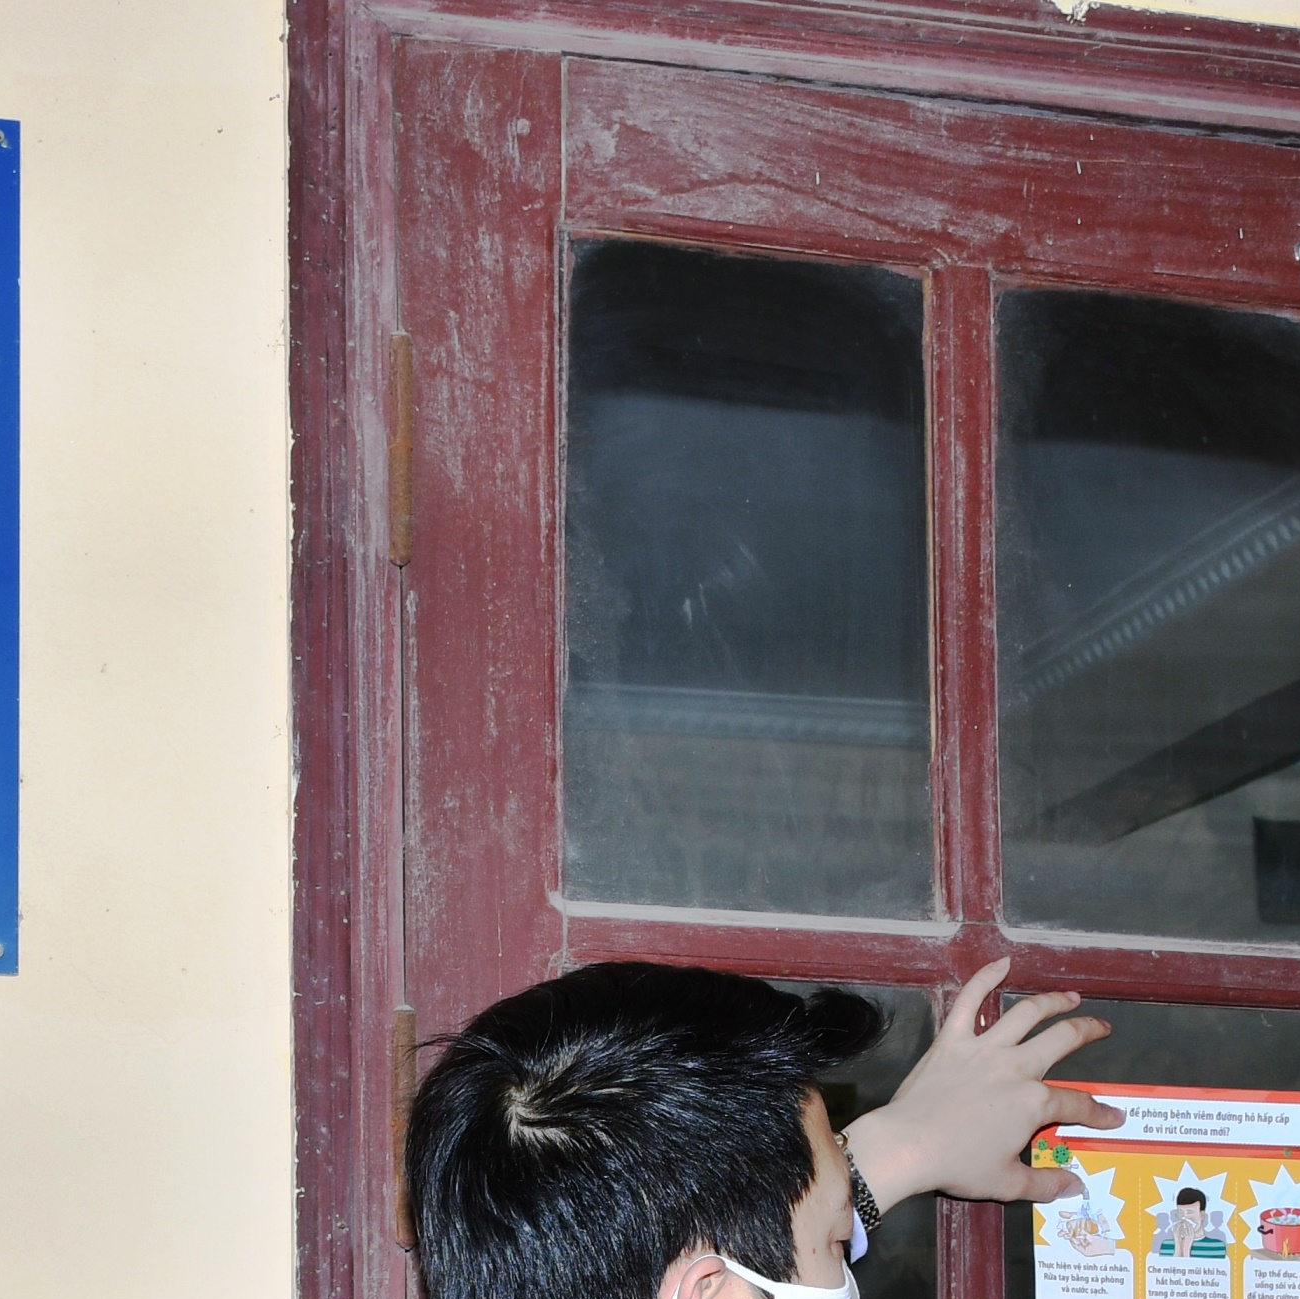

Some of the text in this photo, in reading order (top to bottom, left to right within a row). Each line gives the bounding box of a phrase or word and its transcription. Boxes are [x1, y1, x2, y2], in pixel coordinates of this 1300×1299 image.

[1142, 1108, 1168, 1121] phòng
[1170, 1109, 1191, 1121] bệnh
[1193, 1110, 1214, 1120] viêm
[1216, 1111, 1242, 1124] đường
[1245, 1112, 1255, 1122] hô
[1257, 1112, 1273, 1125] hấp
[1275, 1112, 1290, 1126] cấp
[1143, 1124, 1230, 1136] do vi rút Corona mới?
[1038, 1261, 1130, 1272] Thực hiện vệ sinh cá nhân.
[1163, 1267, 1186, 1276] miệng
[1188, 1267, 1201, 1275] mũi
[1203, 1267, 1215, 1275] khi
[1216, 1268, 1227, 1276] ho,
[1254, 1269, 1267, 1279] Tập
[1282, 1270, 1298, 1279] dục,
[1058, 1274, 1069, 1282] tay
[1071, 1274, 1089, 1284] bằng
[1091, 1274, 1099, 1282] xà
[1101, 1275, 1124, 1285] phòng
[1169, 1278, 1183, 1286] hơi.
[1185, 1278, 1200, 1286] Đeo
[1061, 1285, 1108, 1296] và nước sạch.
[1255, 1281, 1273, 1290] uống
[1275, 1281, 1286, 1289] sôi
[1148, 1289, 1168, 1299] trang
[1170, 1289, 1175, 1297] ở
[1189, 1290, 1207, 1299] công
[1209, 1291, 1229, 1299] cộng.
